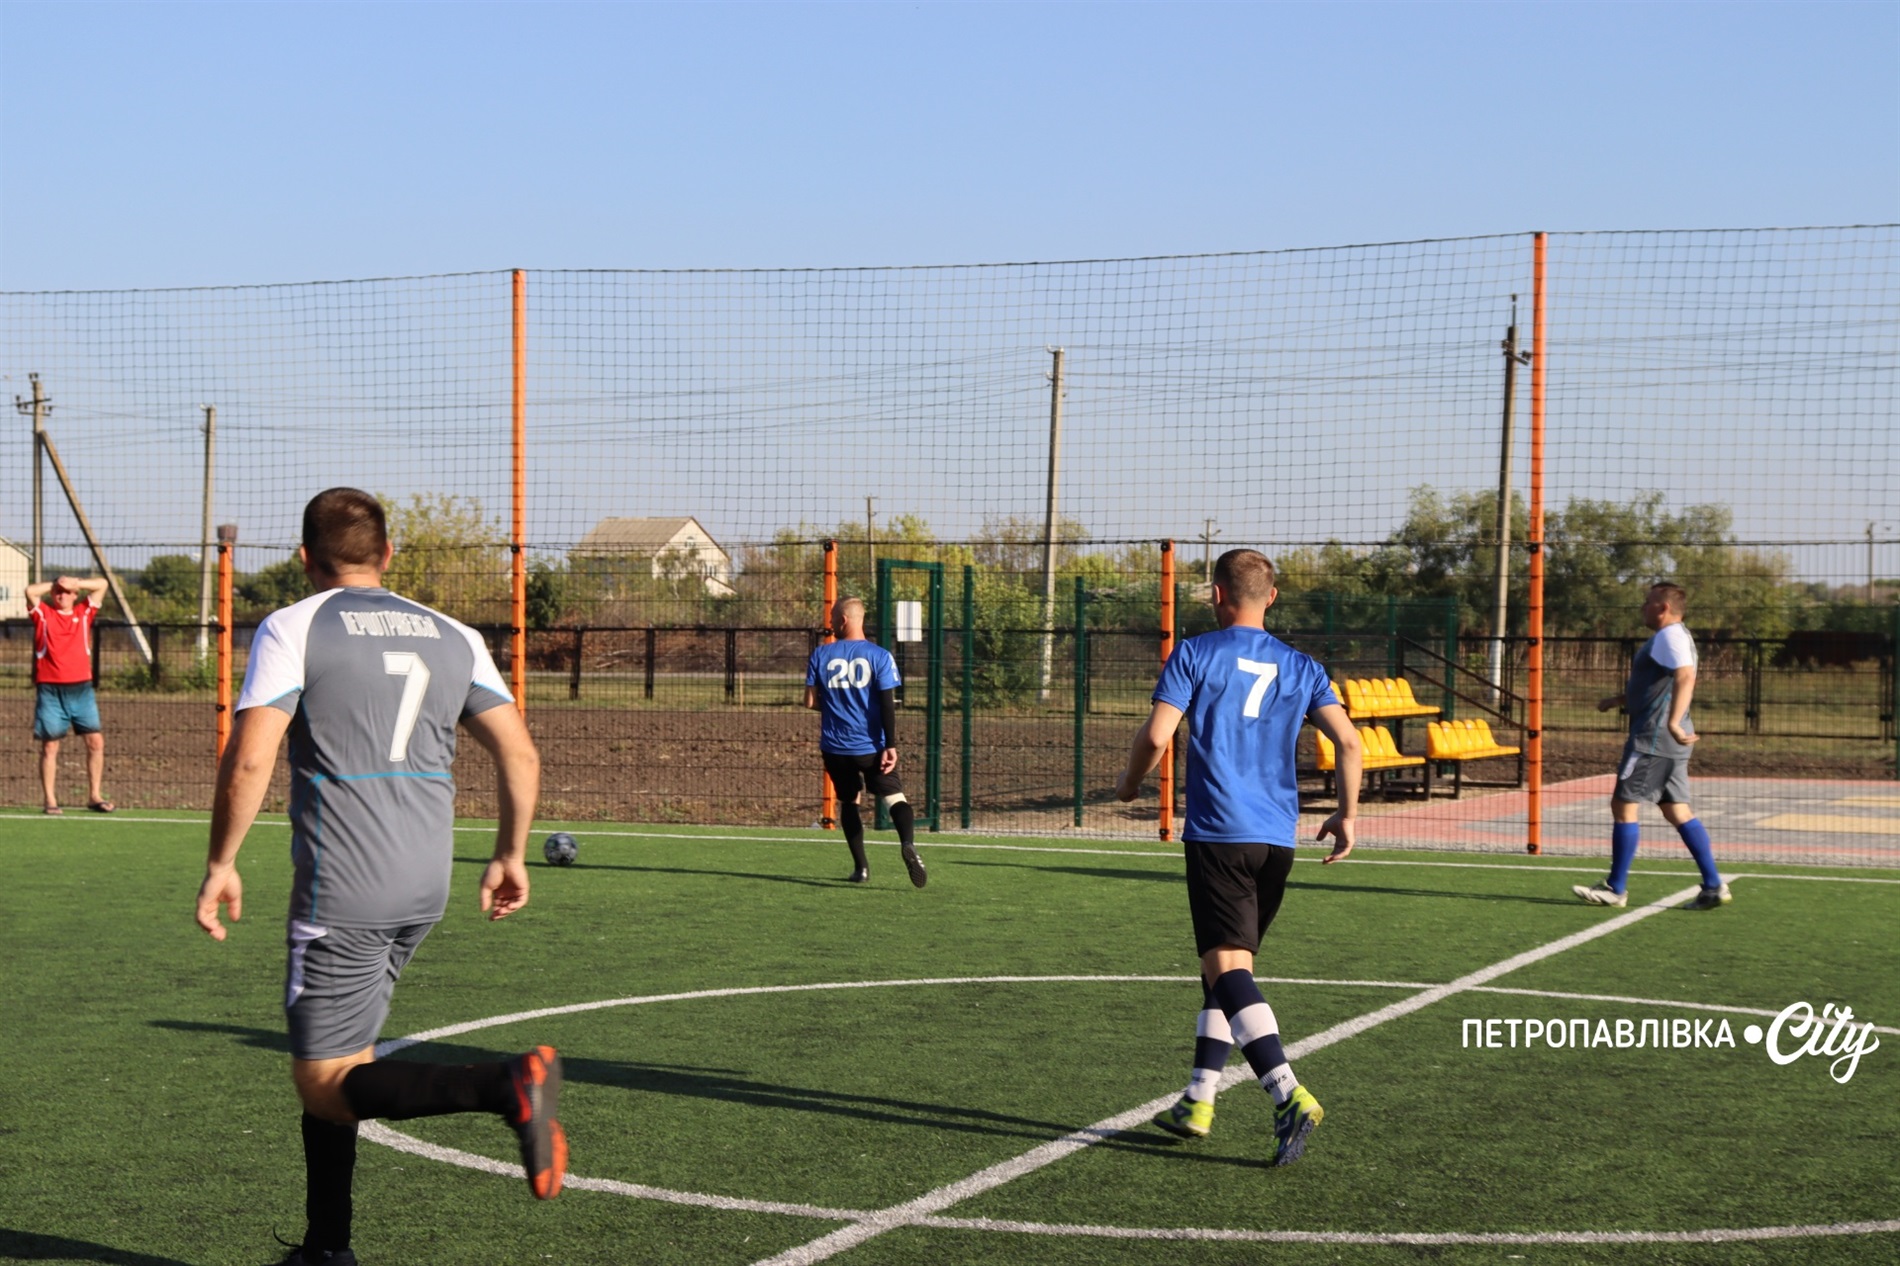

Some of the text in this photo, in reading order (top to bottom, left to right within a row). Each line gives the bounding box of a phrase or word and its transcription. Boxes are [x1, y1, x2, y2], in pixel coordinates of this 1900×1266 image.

[827, 657, 872, 689] 20
[1237, 657, 1278, 718] 7
[382, 651, 431, 762] 7
